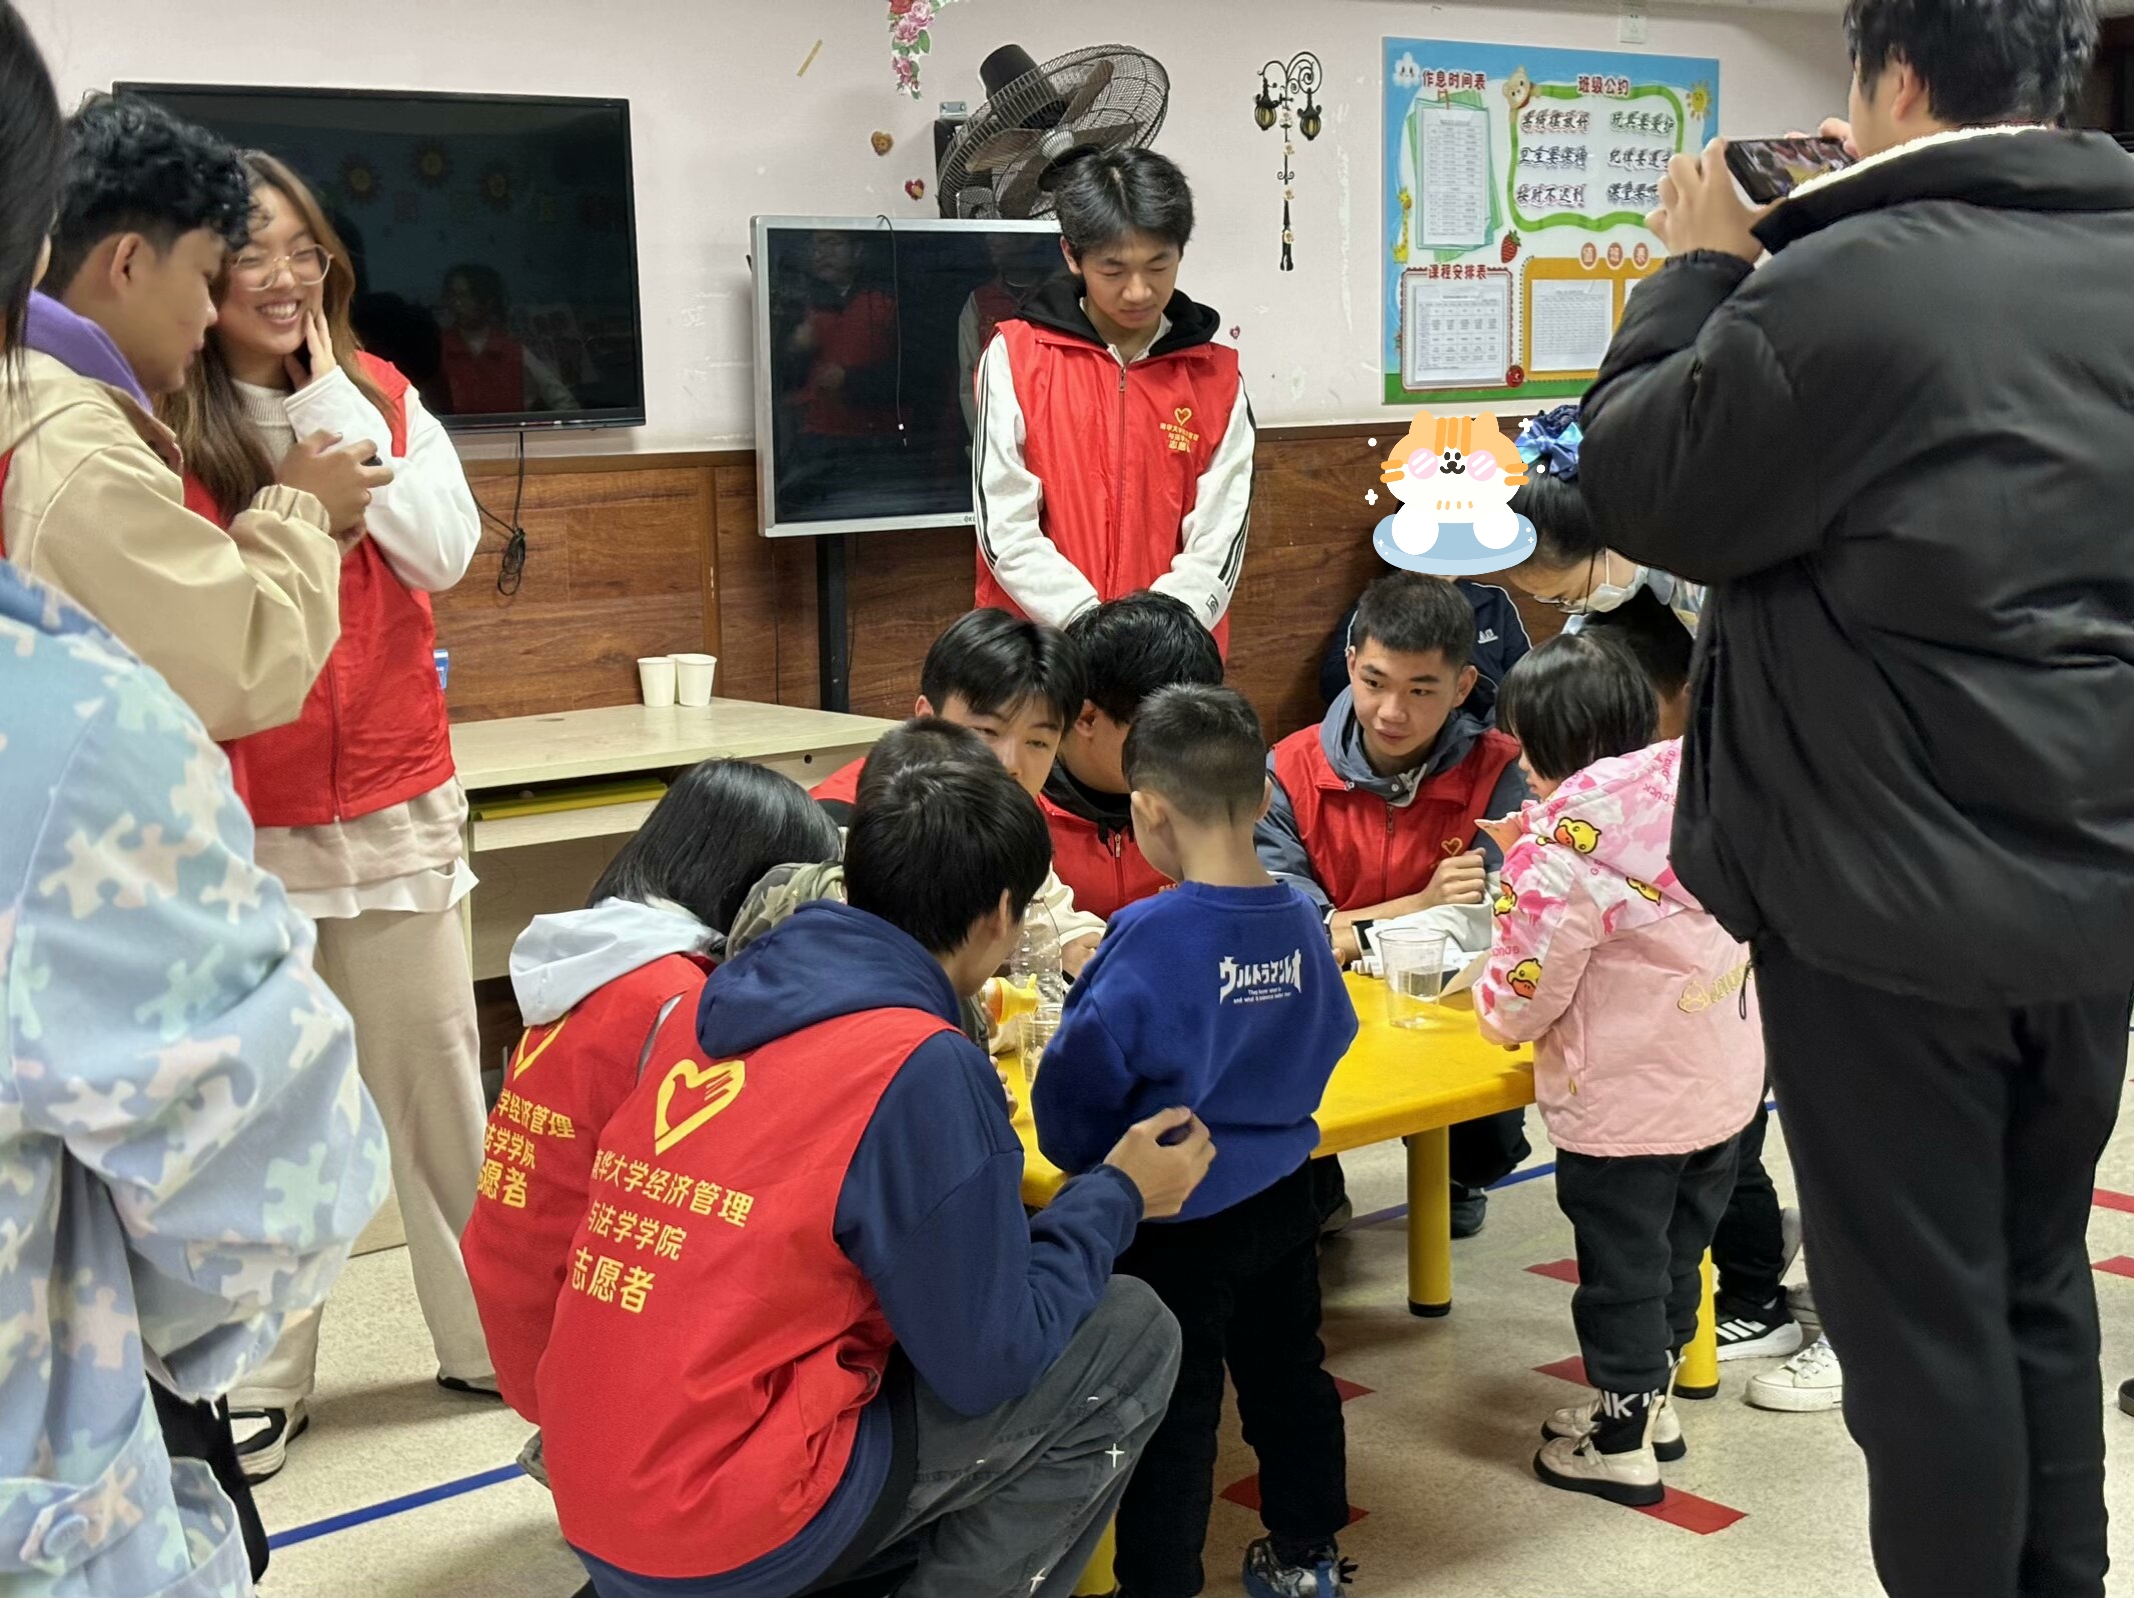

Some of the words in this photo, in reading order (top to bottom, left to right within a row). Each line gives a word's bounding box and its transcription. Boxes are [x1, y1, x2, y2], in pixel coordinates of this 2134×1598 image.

[1422, 69, 1486, 90] 作息时间表
[1578, 75, 1629, 96] 班级公约
[1517, 184, 1586, 208] 按时不迟到
[1428, 264, 1487, 280] 课程安排表
[493, 1088, 576, 1139] 学经济管理
[588, 1200, 688, 1261] 与法学学院
[572, 1246, 656, 1315] 志愿者
